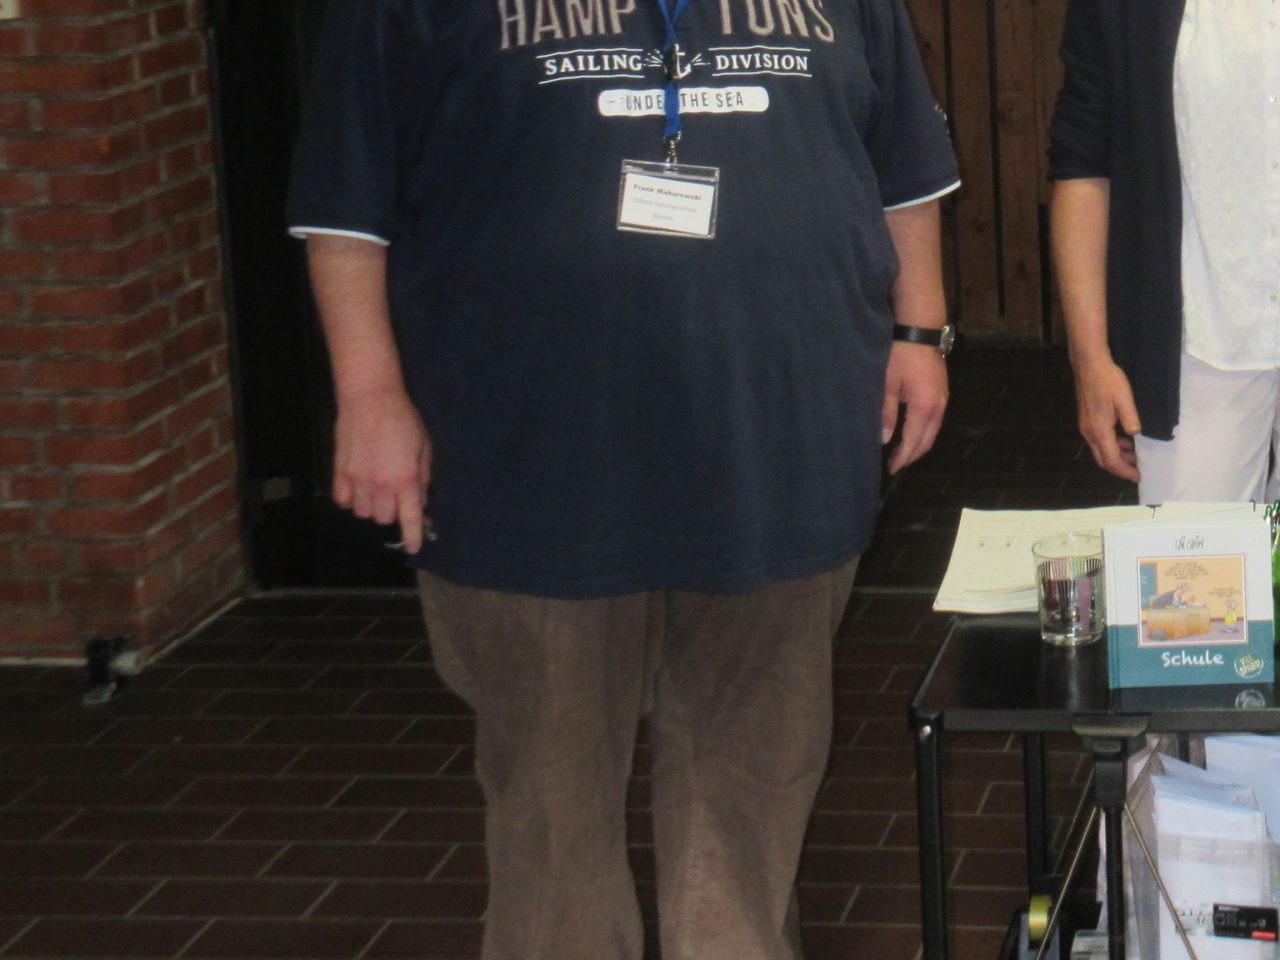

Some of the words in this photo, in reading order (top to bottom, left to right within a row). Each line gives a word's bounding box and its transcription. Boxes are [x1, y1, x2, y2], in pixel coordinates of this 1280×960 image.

[544, 52, 644, 77] SAILING
[715, 52, 809, 73] DIVISION
[626, 94, 663, 112] UNDE
[681, 92, 709, 108] THE
[716, 91, 744, 108] SEA
[1161, 649, 1224, 667] Schule
